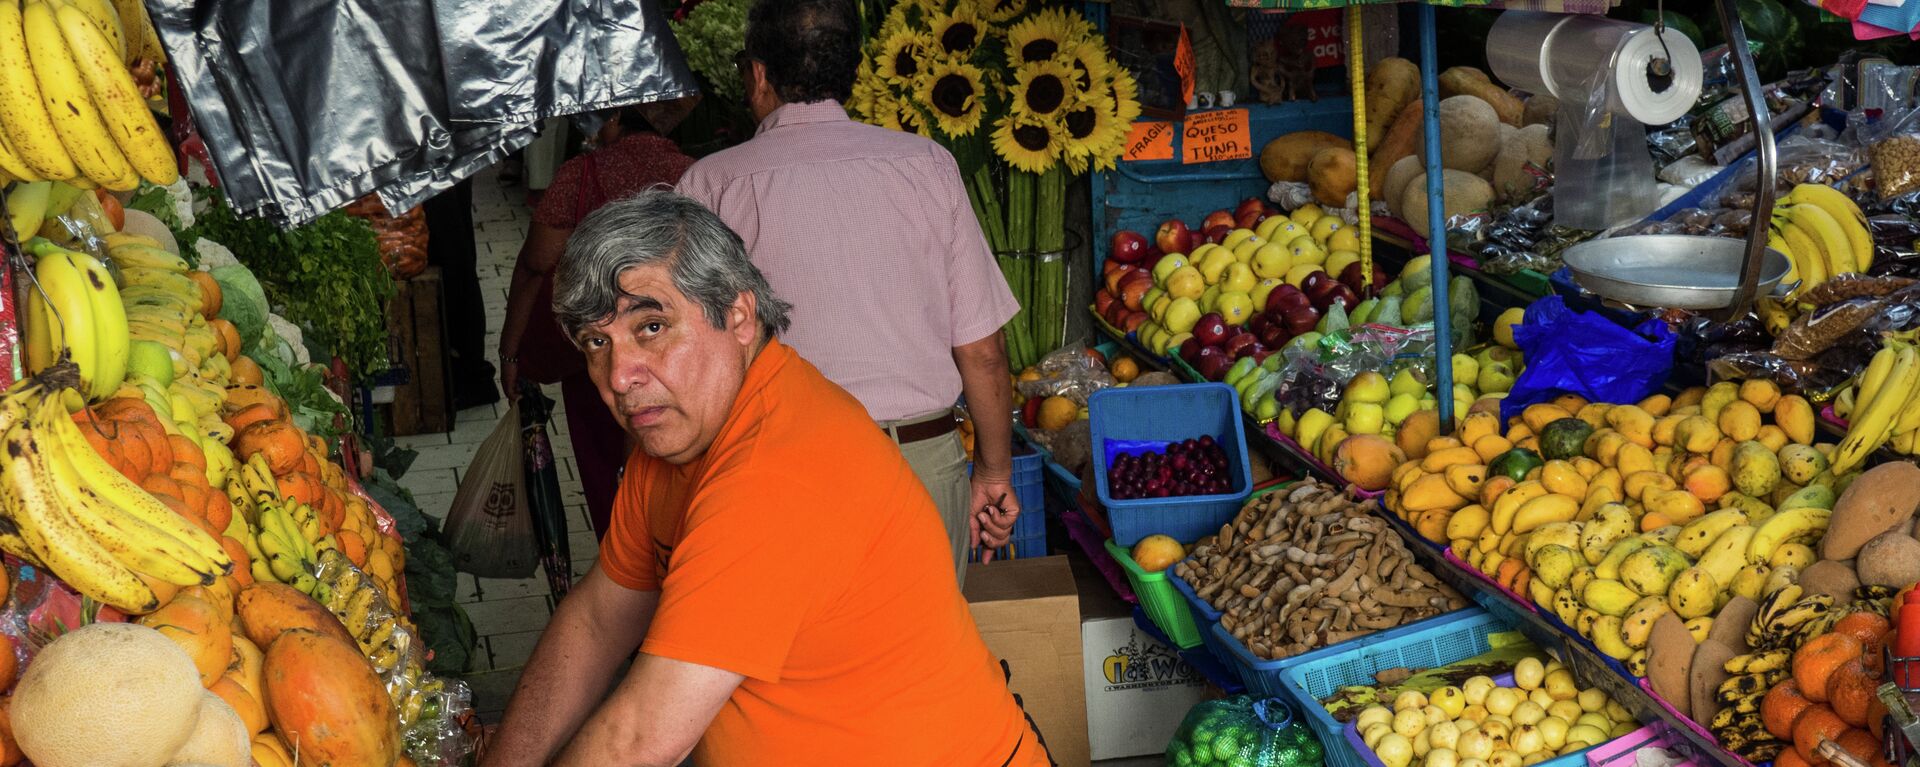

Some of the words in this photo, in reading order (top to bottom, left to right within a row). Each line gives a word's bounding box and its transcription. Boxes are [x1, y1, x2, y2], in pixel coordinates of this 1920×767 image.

[1320, 24, 1342, 39] ve
[1313, 42, 1345, 60] aqu
[1186, 122, 1238, 138] QUESO
[1204, 134, 1217, 143] DE
[1129, 122, 1168, 158] FRAGIL
[1191, 141, 1238, 160] TUNA
[1150, 656, 1197, 682] WO
